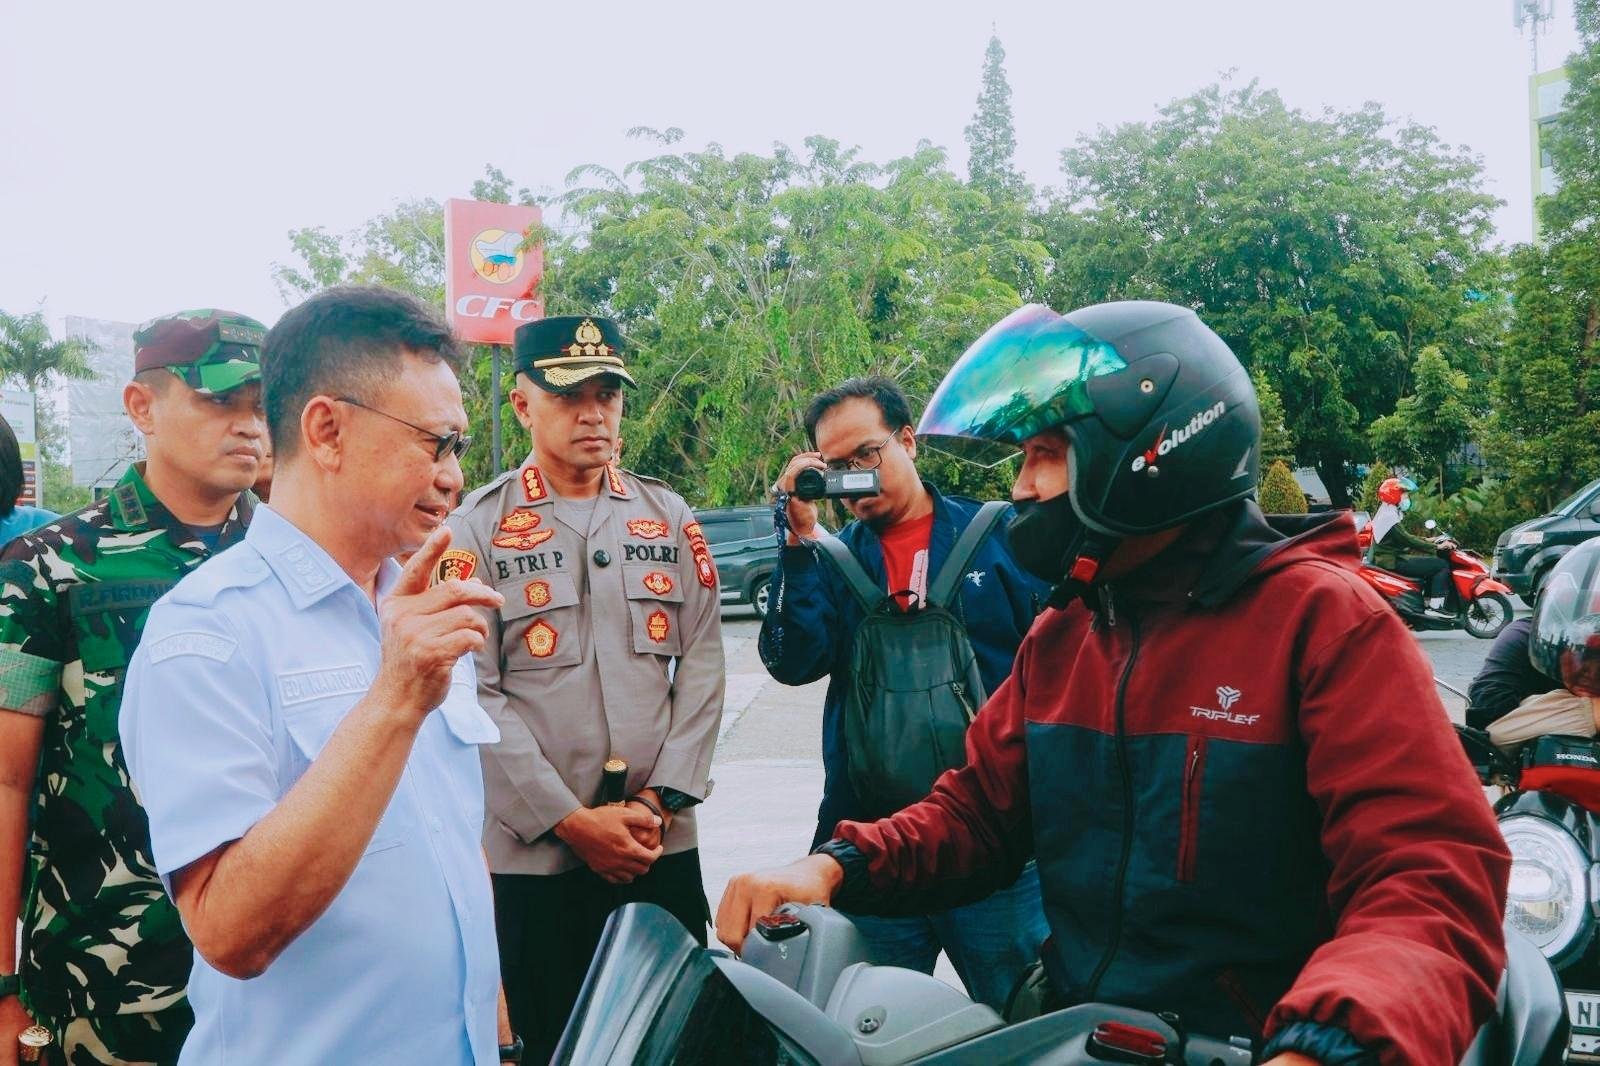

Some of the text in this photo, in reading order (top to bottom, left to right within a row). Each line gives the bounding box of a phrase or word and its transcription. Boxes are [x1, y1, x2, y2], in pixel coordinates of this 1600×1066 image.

[456, 295, 541, 321] CFC
[1131, 401, 1225, 472] evolution
[496, 551, 563, 580] E TRI P
[623, 544, 679, 564] POLRI
[1556, 753, 1598, 763] HONDA
